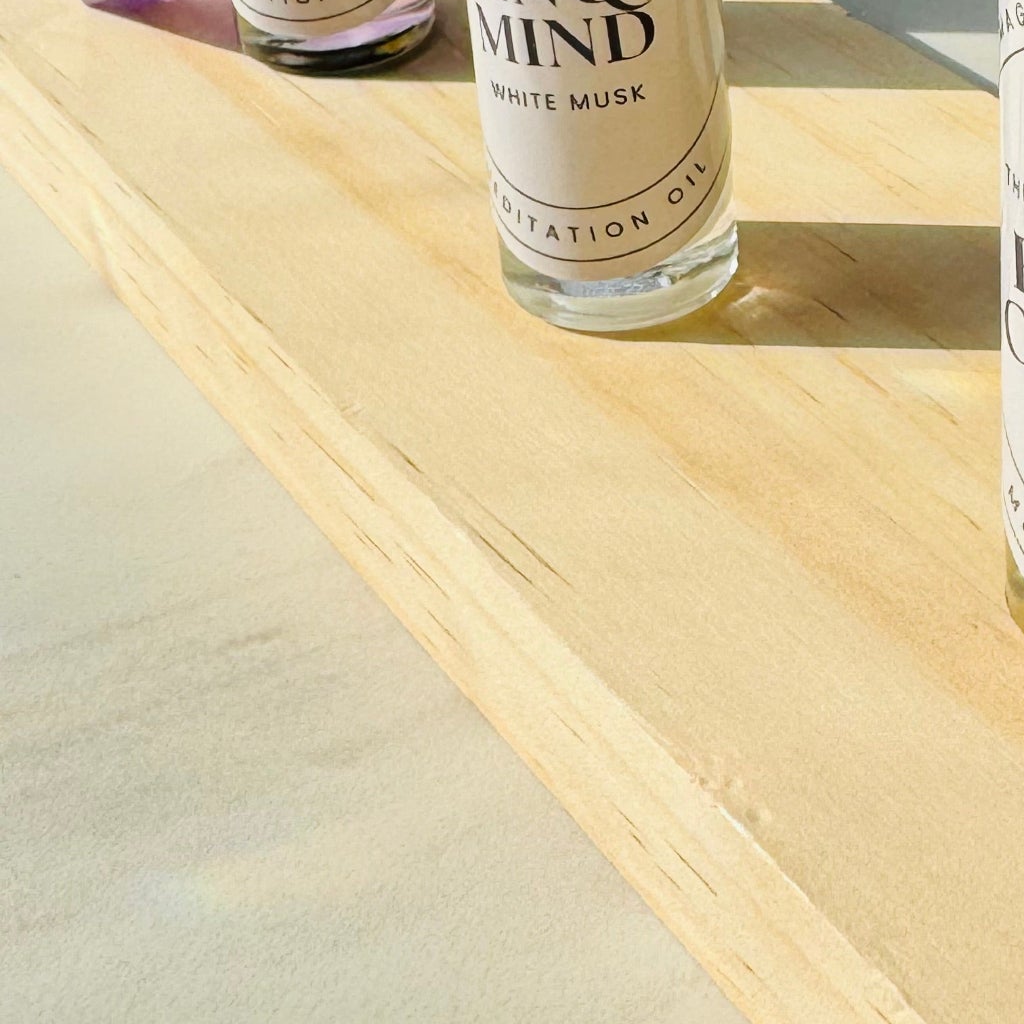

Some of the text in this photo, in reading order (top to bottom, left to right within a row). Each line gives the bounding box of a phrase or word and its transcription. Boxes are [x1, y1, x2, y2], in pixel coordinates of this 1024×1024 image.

[475, 1, 656, 68] MIND
[490, 80, 647, 111] WHITE MUSK
[667, 162, 707, 205] OIL
